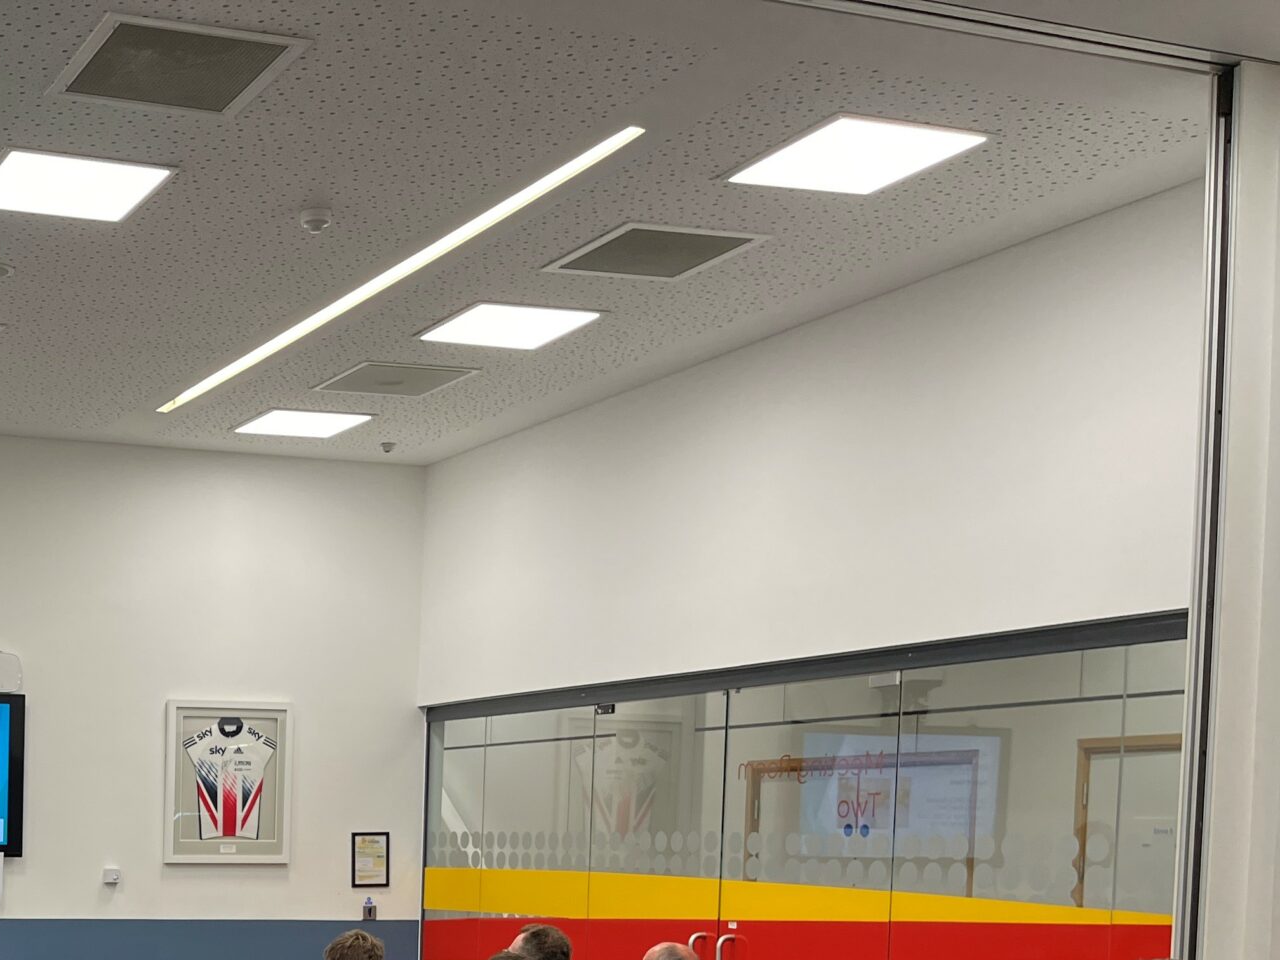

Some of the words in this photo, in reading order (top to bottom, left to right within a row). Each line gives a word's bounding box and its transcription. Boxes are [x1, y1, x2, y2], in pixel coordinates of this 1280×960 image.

[196, 728, 213, 741] sky
[246, 727, 264, 741] sky
[209, 746, 226, 756] sky
